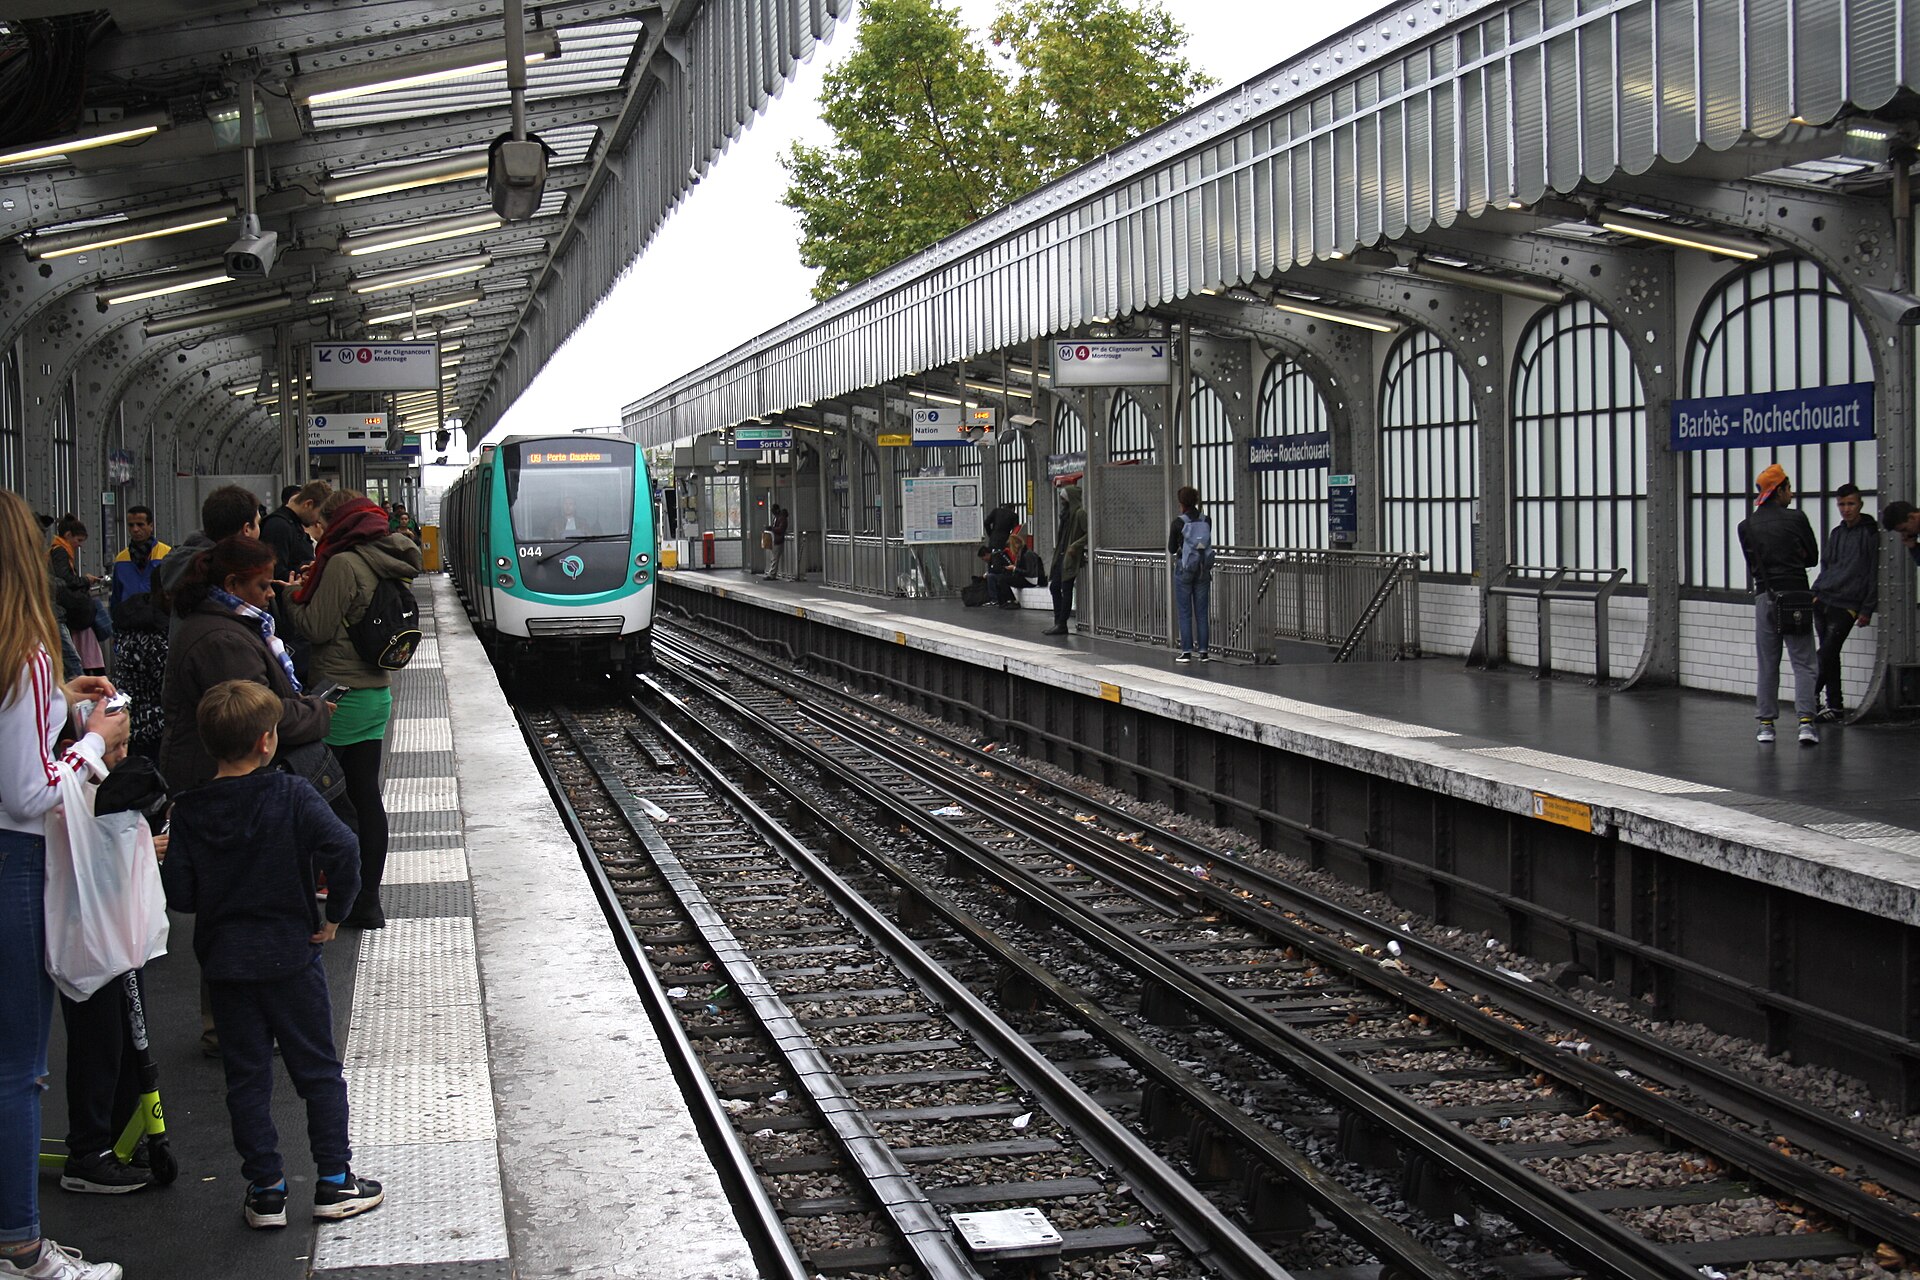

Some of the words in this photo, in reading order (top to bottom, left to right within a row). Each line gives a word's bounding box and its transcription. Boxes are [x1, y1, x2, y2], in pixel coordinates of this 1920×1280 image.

[392, 348, 431, 357] Clignancourt
[308, 438, 335, 446] auphine
[760, 440, 783, 448] Sortie
[547, 453, 567, 461] Porte
[569, 453, 601, 462] Dauphine
[519, 546, 542, 558] 044
